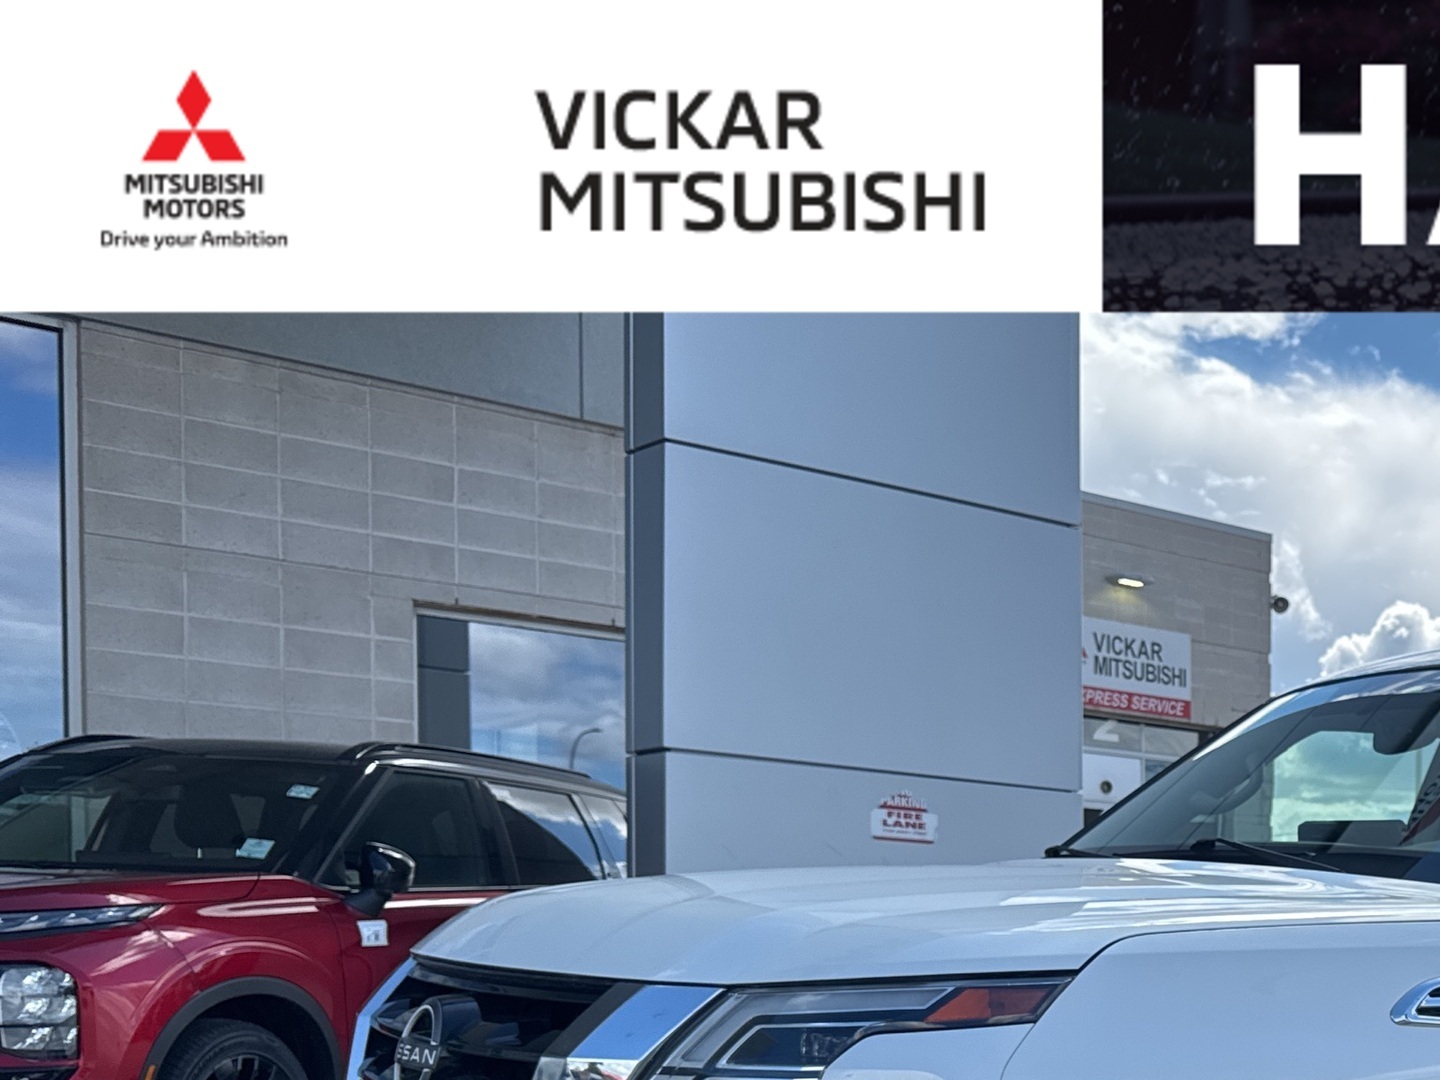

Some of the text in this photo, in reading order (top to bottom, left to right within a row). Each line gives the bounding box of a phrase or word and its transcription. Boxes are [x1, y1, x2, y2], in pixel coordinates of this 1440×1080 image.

[1093, 631, 1163, 662] VICKAR
[1093, 656, 1187, 688] MITSUBISHI
[1131, 695, 1185, 716] SERVICE
[883, 819, 925, 829] LANE
[888, 811, 922, 820] FIRE
[397, 1043, 437, 1064] SSAN
